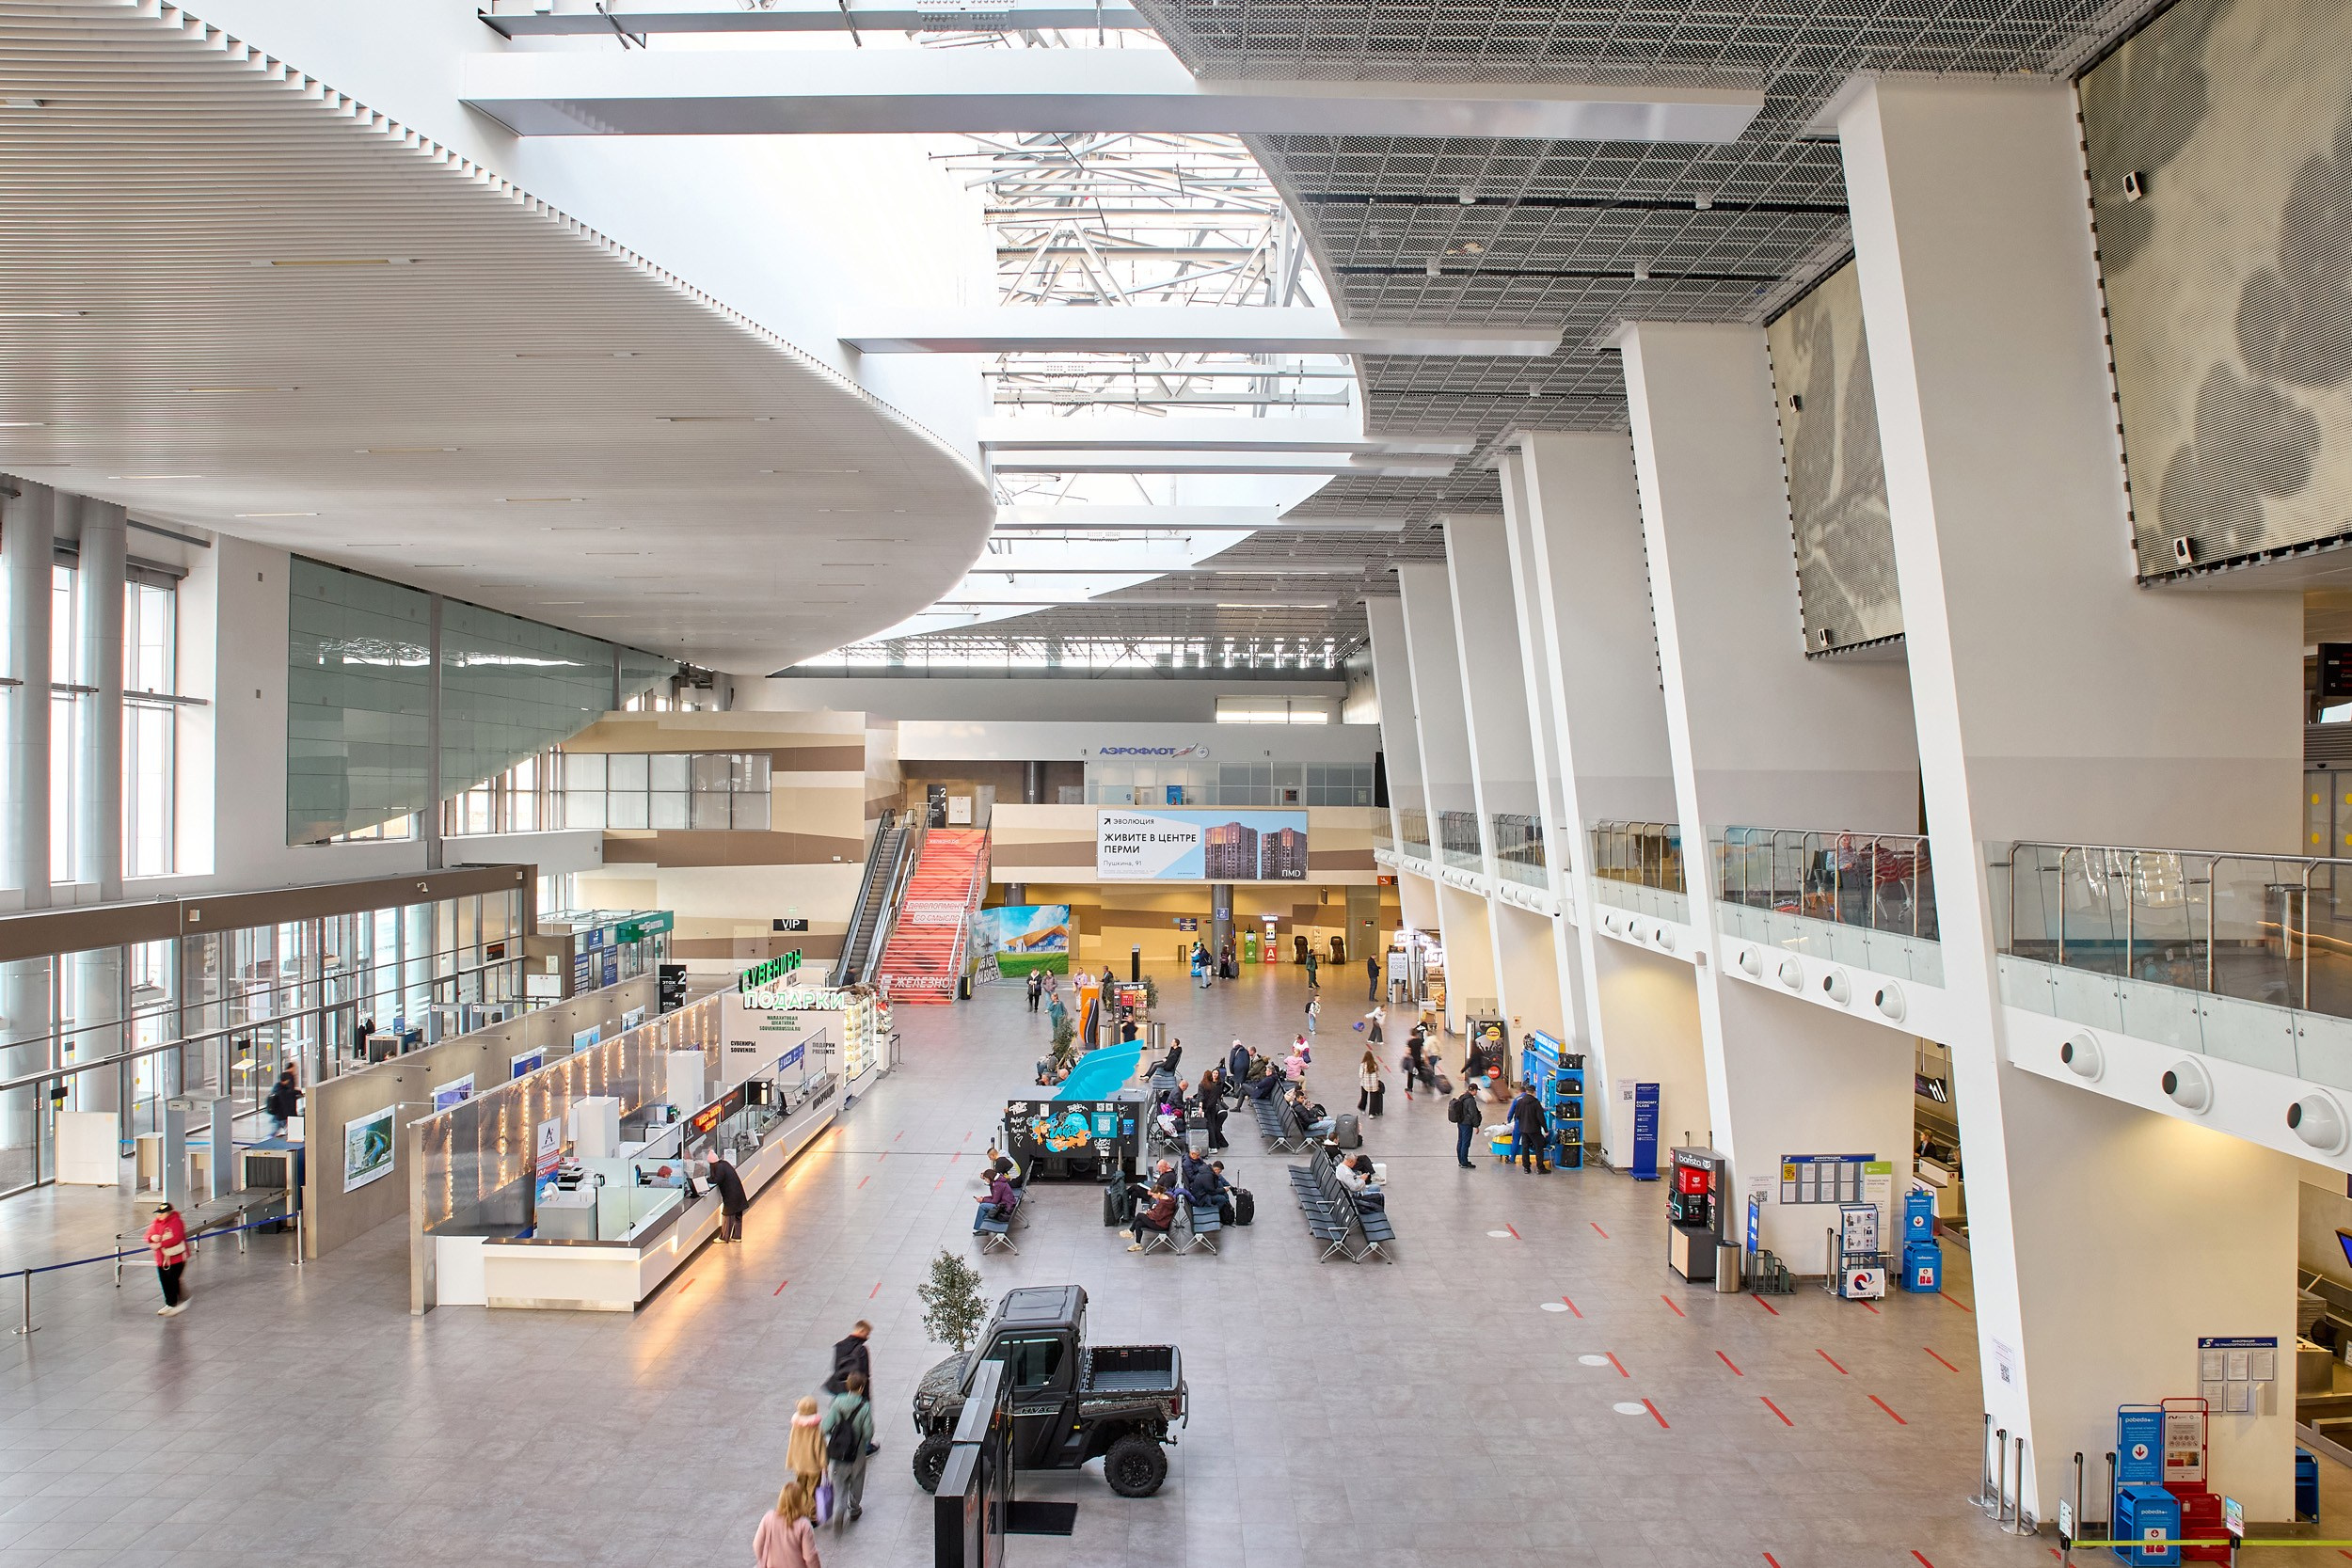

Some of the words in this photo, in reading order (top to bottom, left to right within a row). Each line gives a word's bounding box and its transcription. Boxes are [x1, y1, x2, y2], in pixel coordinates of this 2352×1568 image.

[1100, 747, 1175, 755] АЭРОФЛОТ
[940, 787, 946, 798] 2
[941, 802, 946, 812] 1
[1104, 833, 1147, 842] ЖИВИТЕ
[1150, 833, 1156, 842] В
[1158, 833, 1197, 844] ЦЕНТРЕ
[1104, 845, 1140, 854] ПЕРМИ
[782, 919, 801, 929] VIP
[739, 948, 803, 993] СУВЕНИРЫ
[677, 971, 686, 985] 2
[895, 976, 950, 989] ЖЕЛЕЗНО
[744, 990, 847, 1011] ПОДАРКИ
[1678, 1153, 1702, 1166] barista
[1021, 1406, 1055, 1415] HVAC
